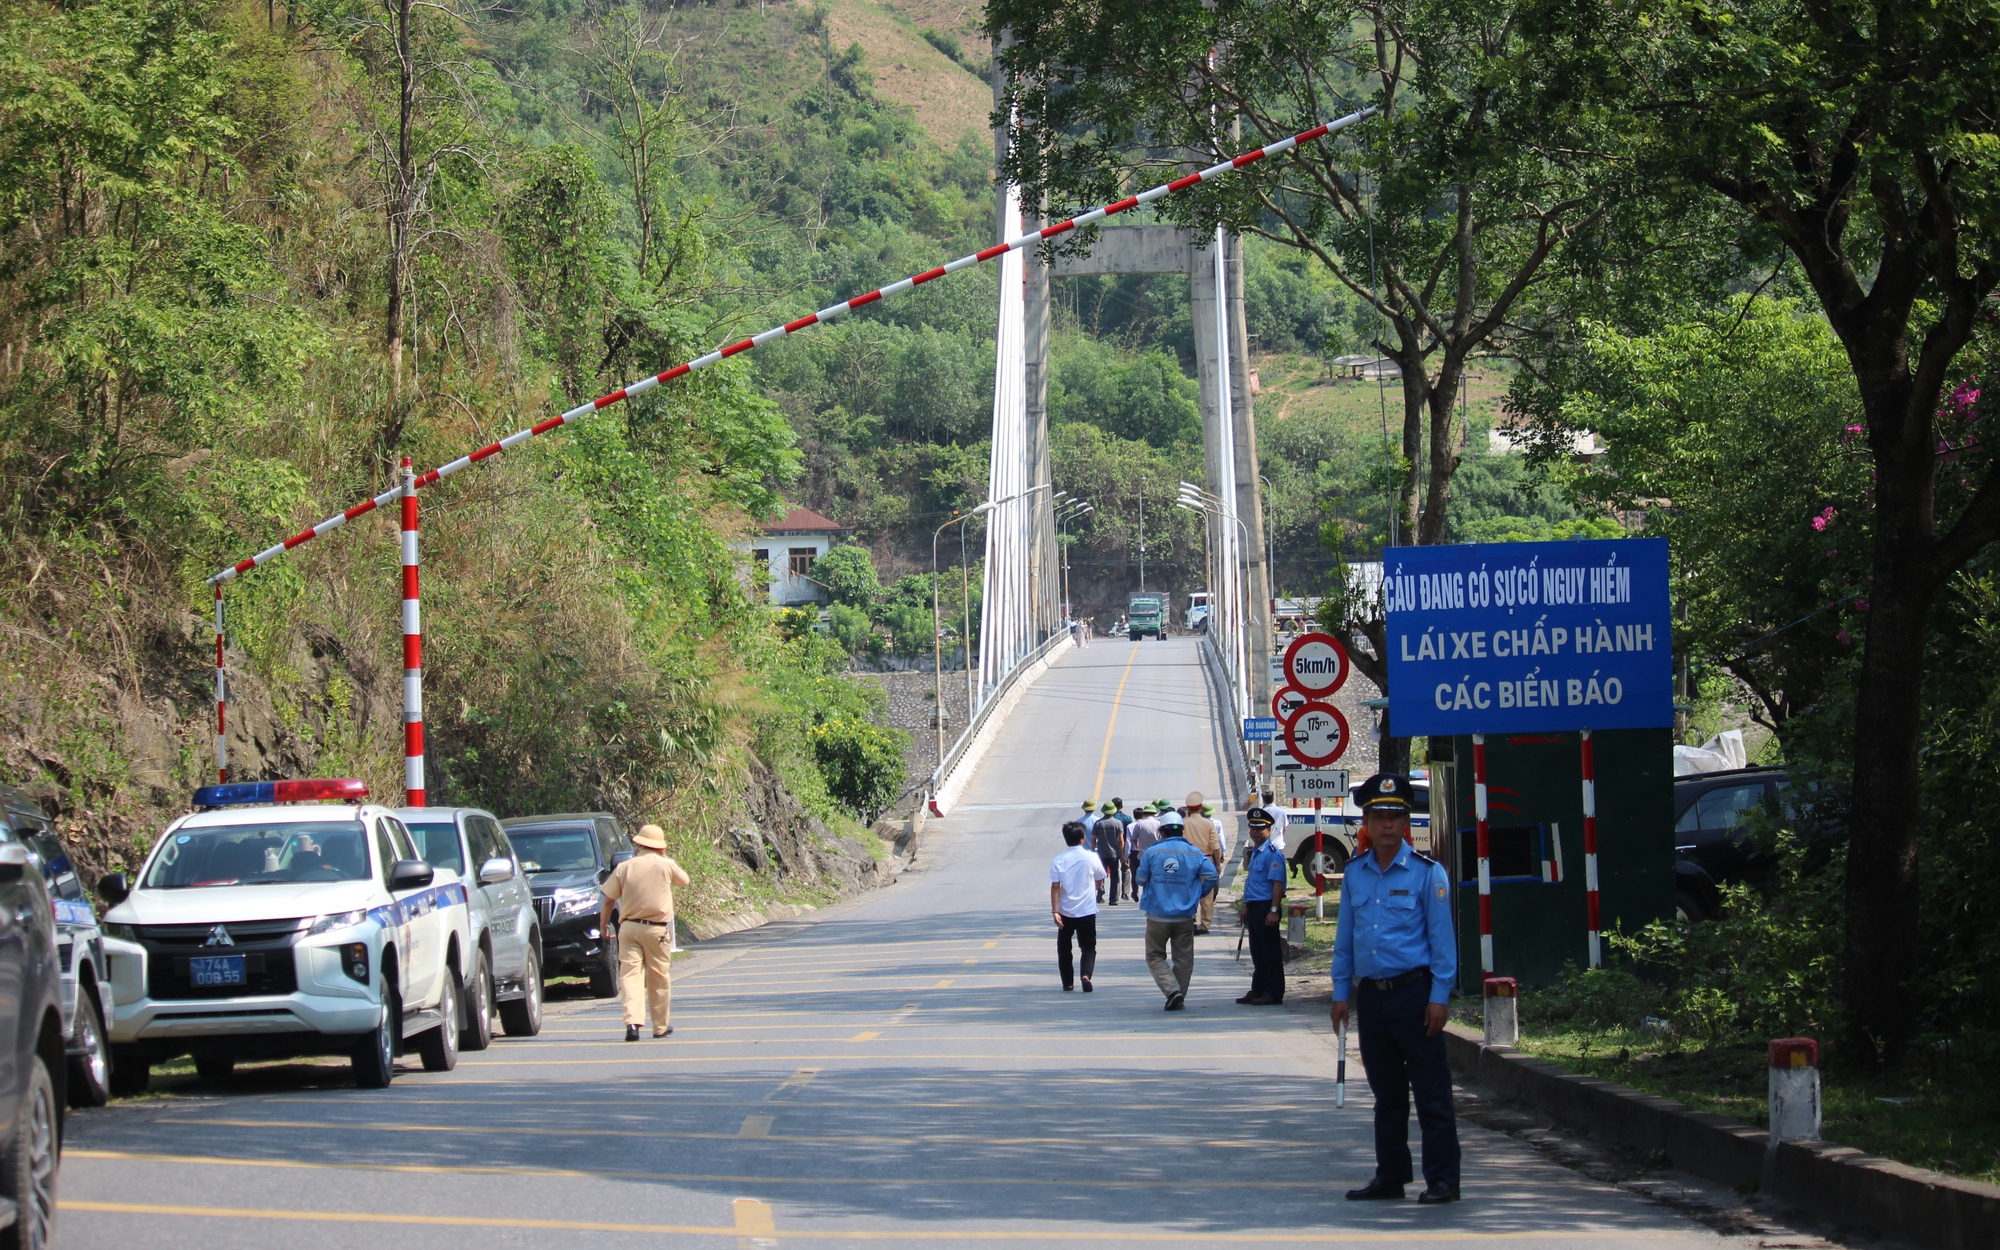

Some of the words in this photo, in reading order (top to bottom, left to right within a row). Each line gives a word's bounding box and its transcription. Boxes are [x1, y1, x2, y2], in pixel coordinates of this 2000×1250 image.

[1384, 563, 1416, 612] CẦU
[1419, 572, 1464, 610] ĐANG
[1468, 563, 1490, 608] CÓ
[1543, 568, 1586, 605] NGUY
[1590, 552, 1631, 604] HIỂM
[1401, 626, 1445, 662] LÁI
[1450, 631, 1487, 659] XE
[1493, 614, 1568, 657] CHẤP
[1575, 618, 1653, 654] HÀNH
[1296, 657, 1336, 674] 5km/h
[1435, 674, 1491, 711] CÁC
[1498, 666, 1560, 709] BIỂN
[1566, 669, 1623, 706] BÁO
[1307, 717, 1329, 731] 175m
[1301, 779, 1335, 789] 180m
[1321, 815, 1330, 824] ÁT
[490, 918, 515, 935] PRADO
[205, 958, 230, 971] 74A
